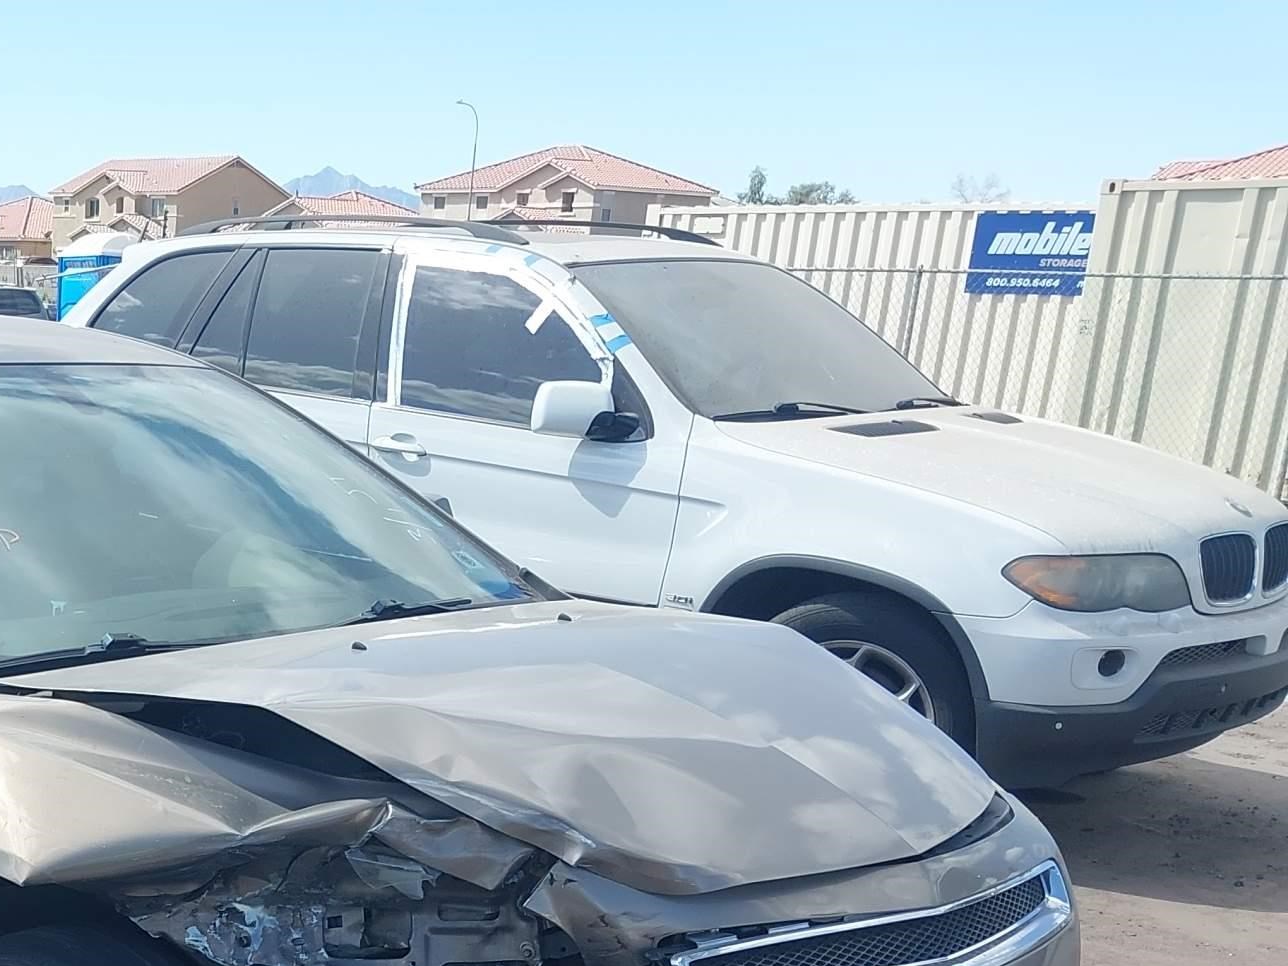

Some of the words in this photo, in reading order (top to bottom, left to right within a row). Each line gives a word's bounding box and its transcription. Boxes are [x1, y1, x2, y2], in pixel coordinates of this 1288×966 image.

[987, 221, 1094, 256] mobile
[1038, 258, 1088, 268] STORAGE
[985, 277, 1061, 288] 800.950.6464
